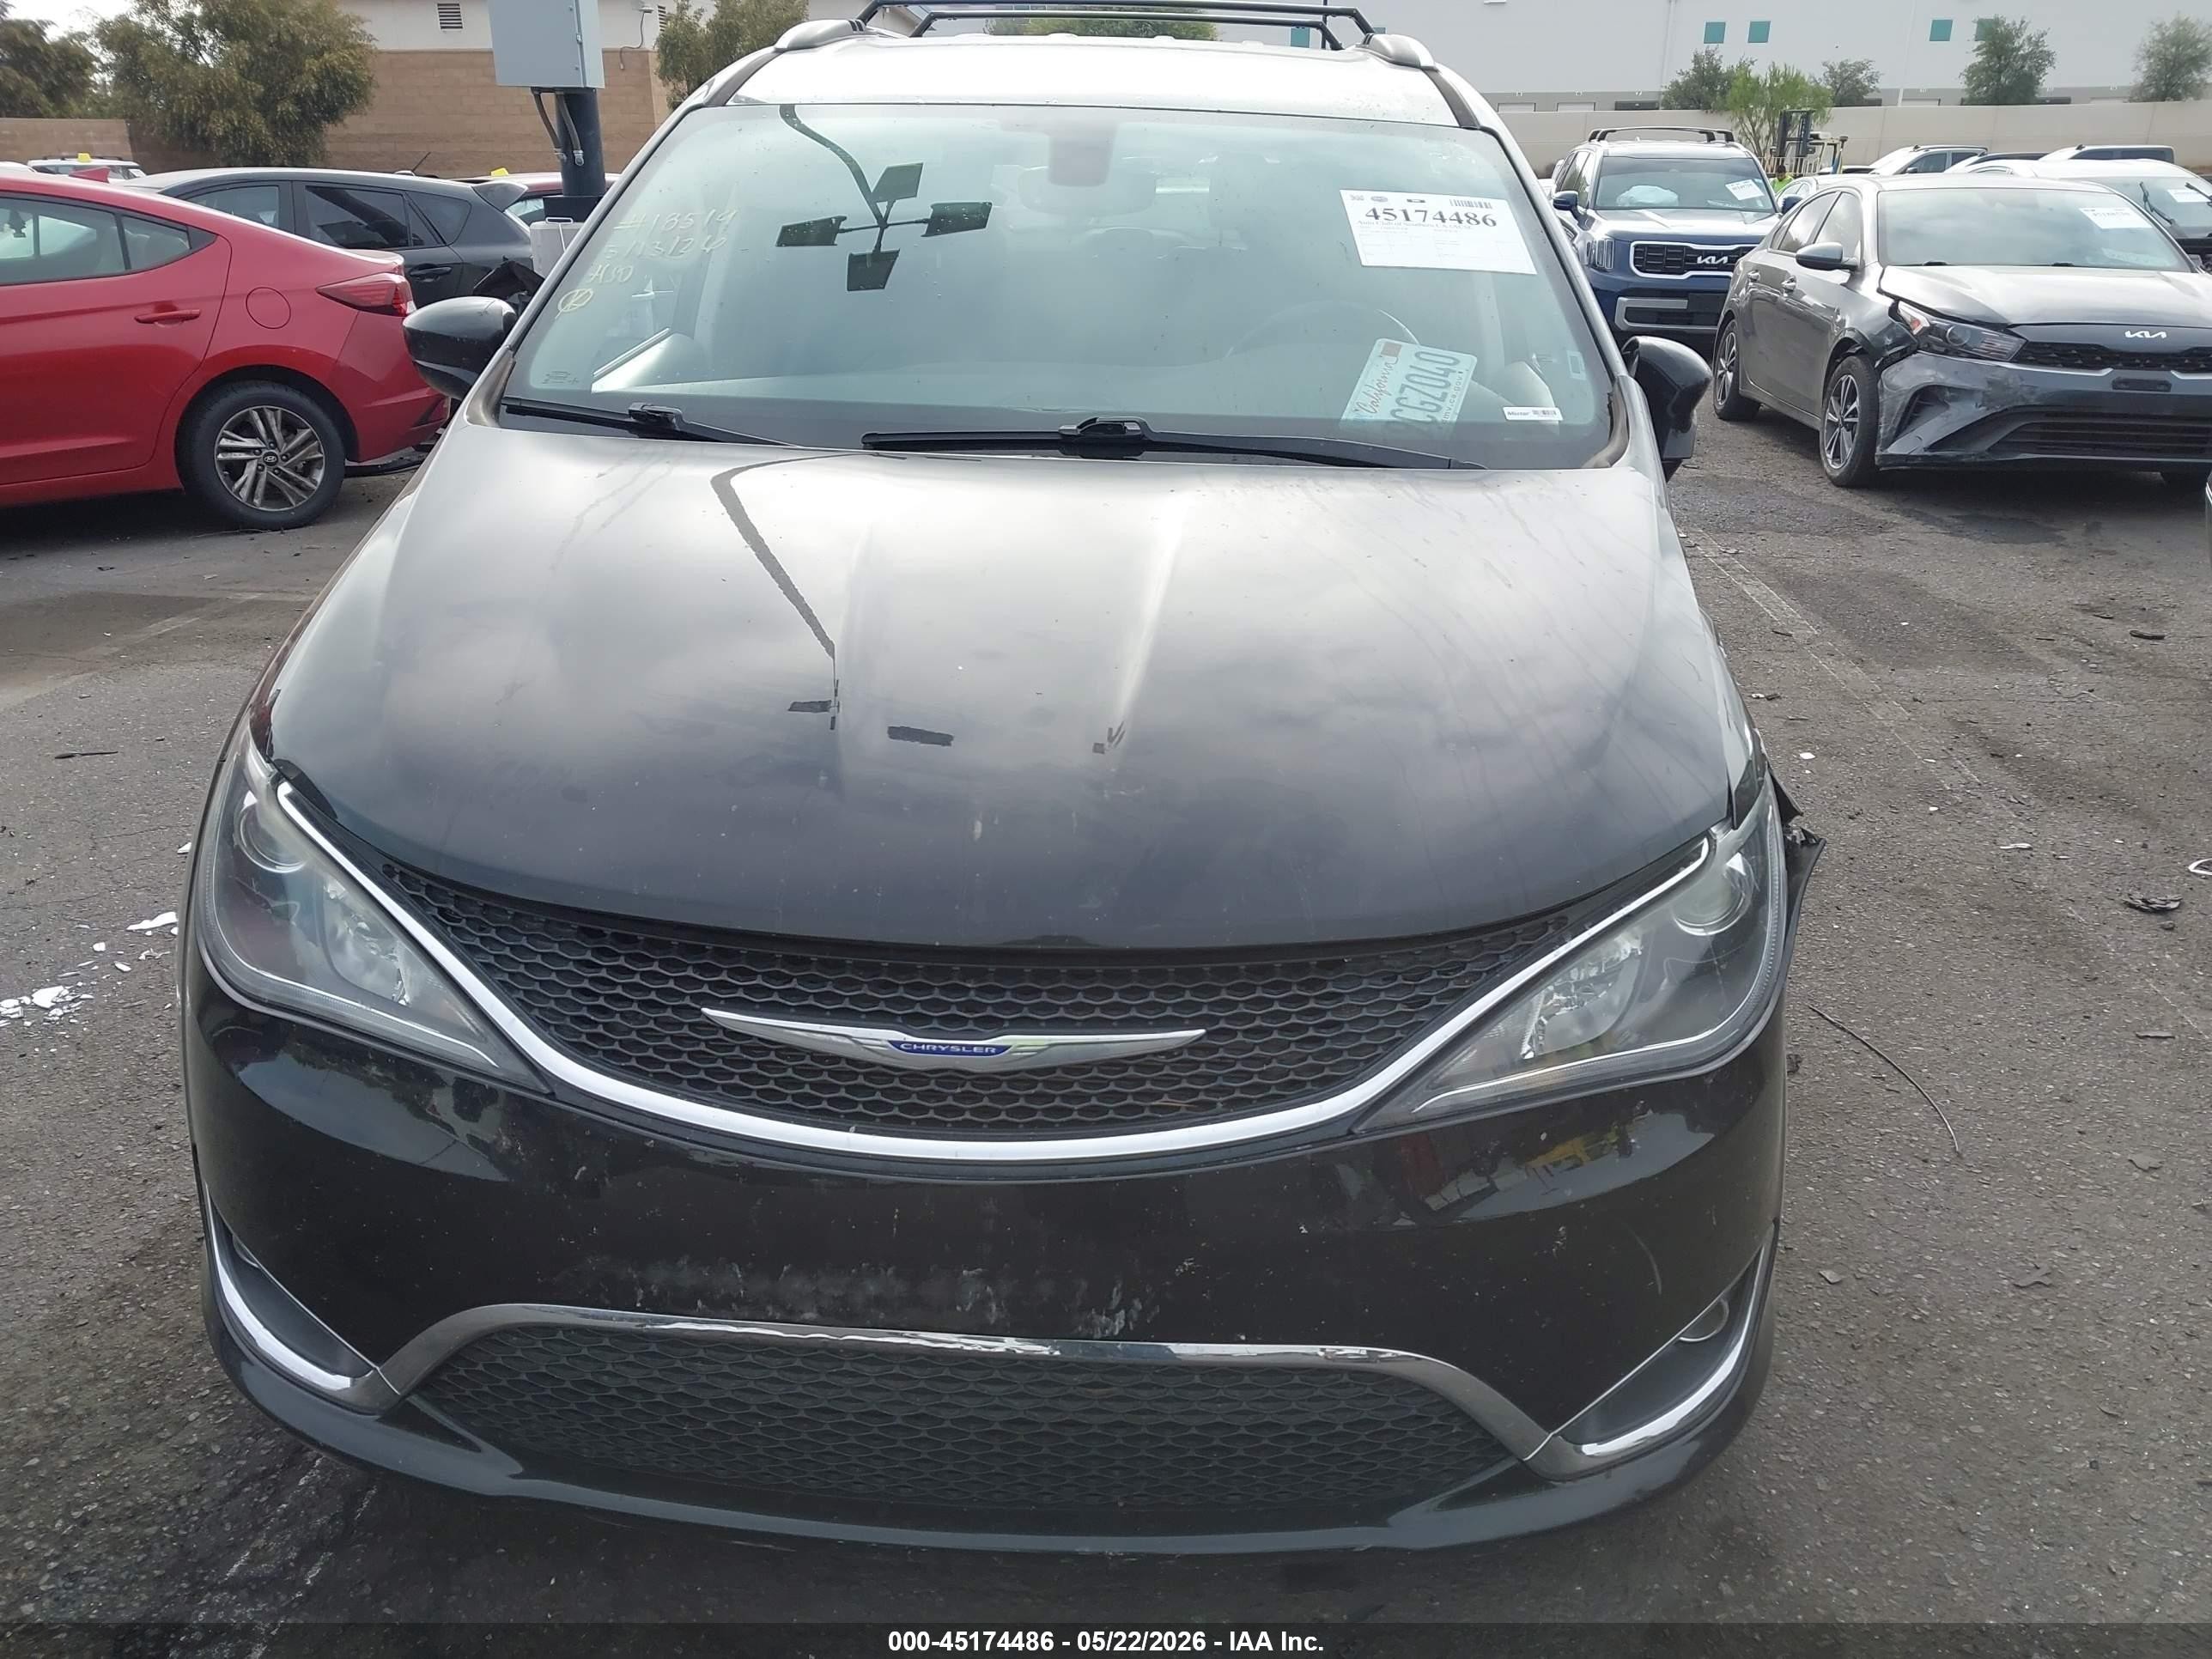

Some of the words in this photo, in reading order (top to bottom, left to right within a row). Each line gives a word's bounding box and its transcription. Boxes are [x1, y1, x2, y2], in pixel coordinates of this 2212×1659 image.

[1364, 207, 1498, 228] 45174486
[1697, 255, 1729, 264] KIA
[2124, 330, 2167, 339] KIA
[1355, 356, 1399, 414] California
[900, 1042, 997, 1054] CHRYSLER
